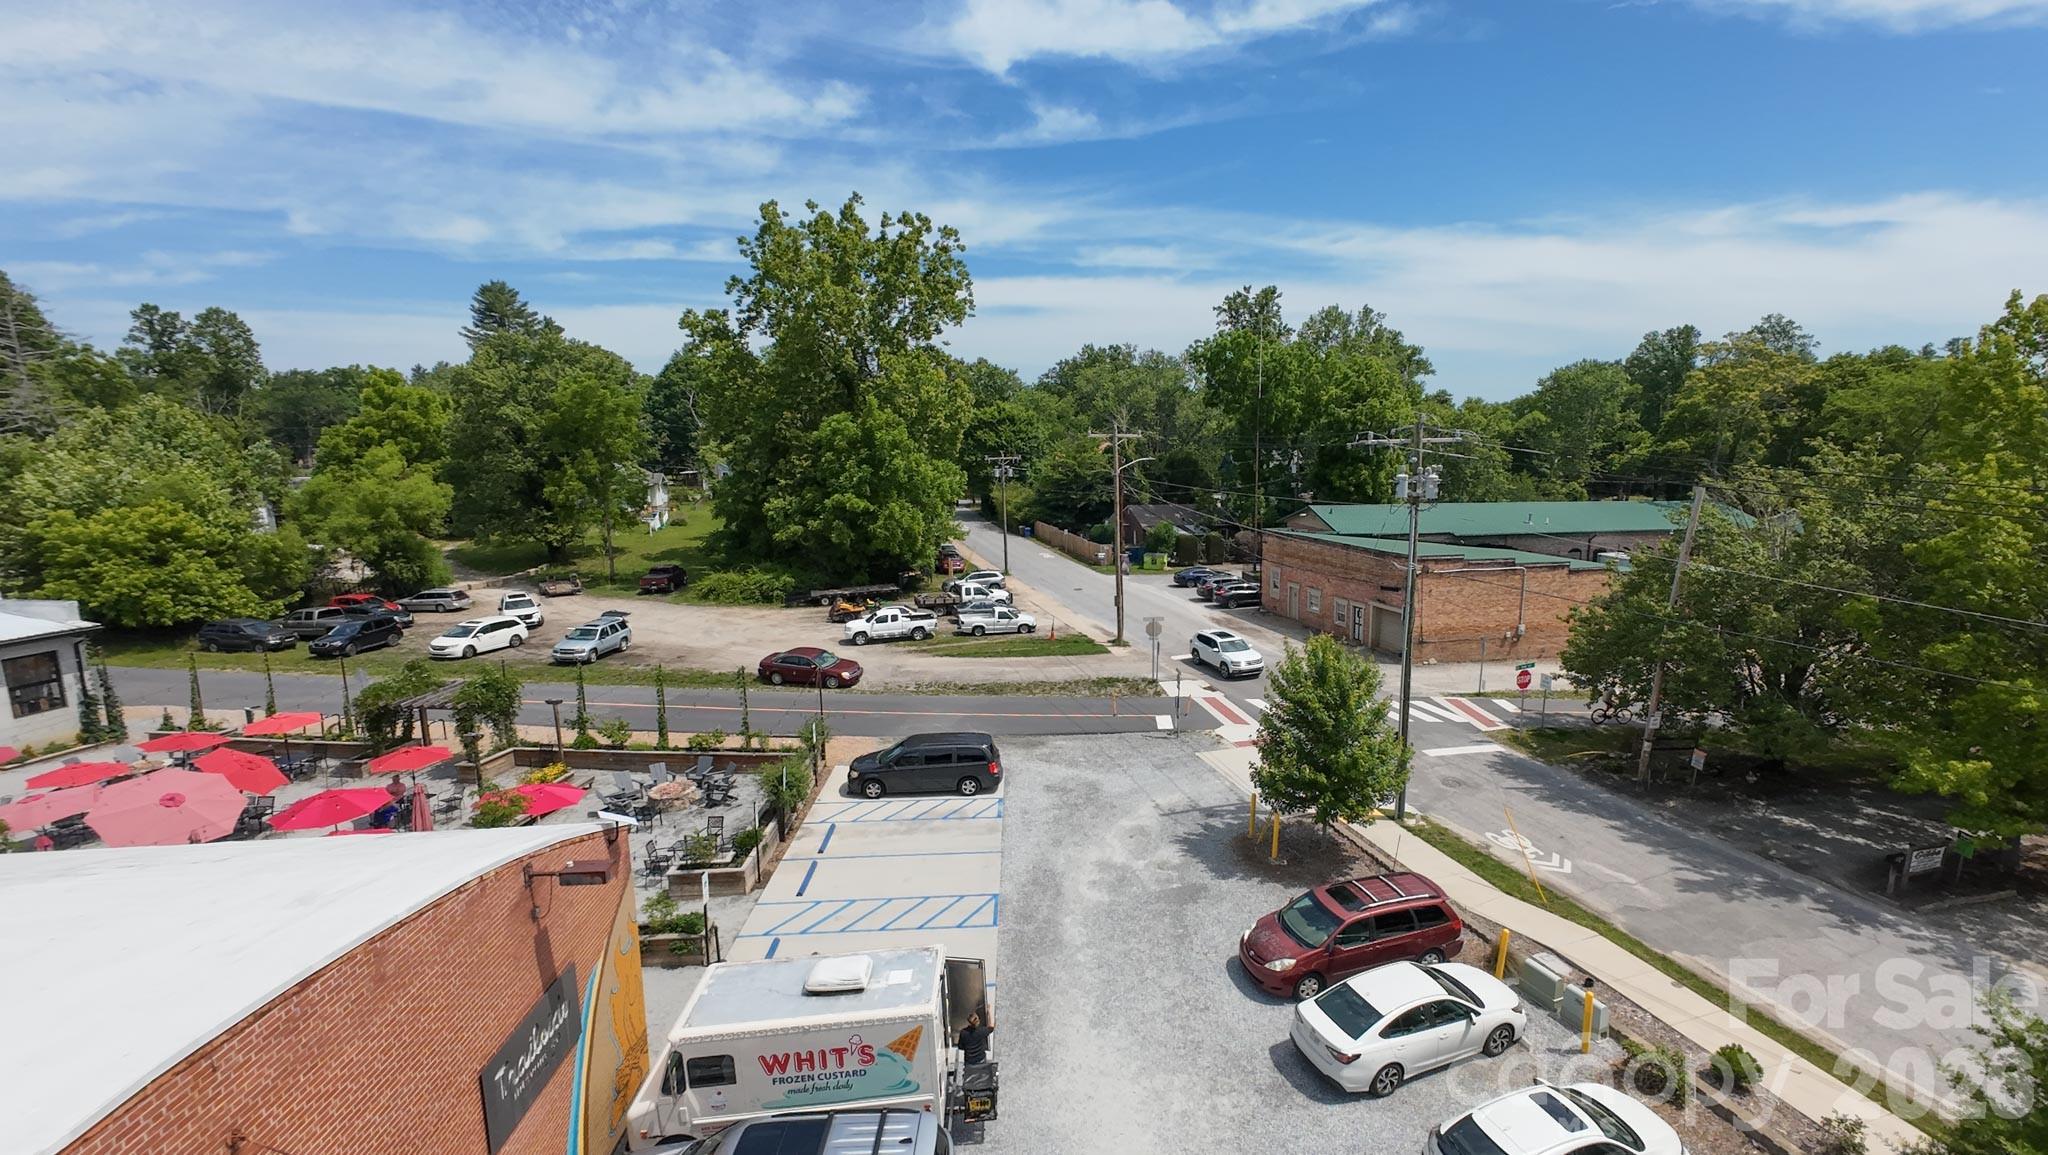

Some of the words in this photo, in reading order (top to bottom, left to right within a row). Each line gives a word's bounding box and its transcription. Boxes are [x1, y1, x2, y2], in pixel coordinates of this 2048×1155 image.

[1517, 675, 1531, 684] STOP
[758, 1044, 876, 1076] WHIT'S
[772, 1075, 815, 1086] FROZEN
[817, 1069, 867, 1081] CUSTARD
[787, 1083, 810, 1095] made
[809, 1082, 831, 1095] fresh
[832, 1079, 853, 1091] daily
